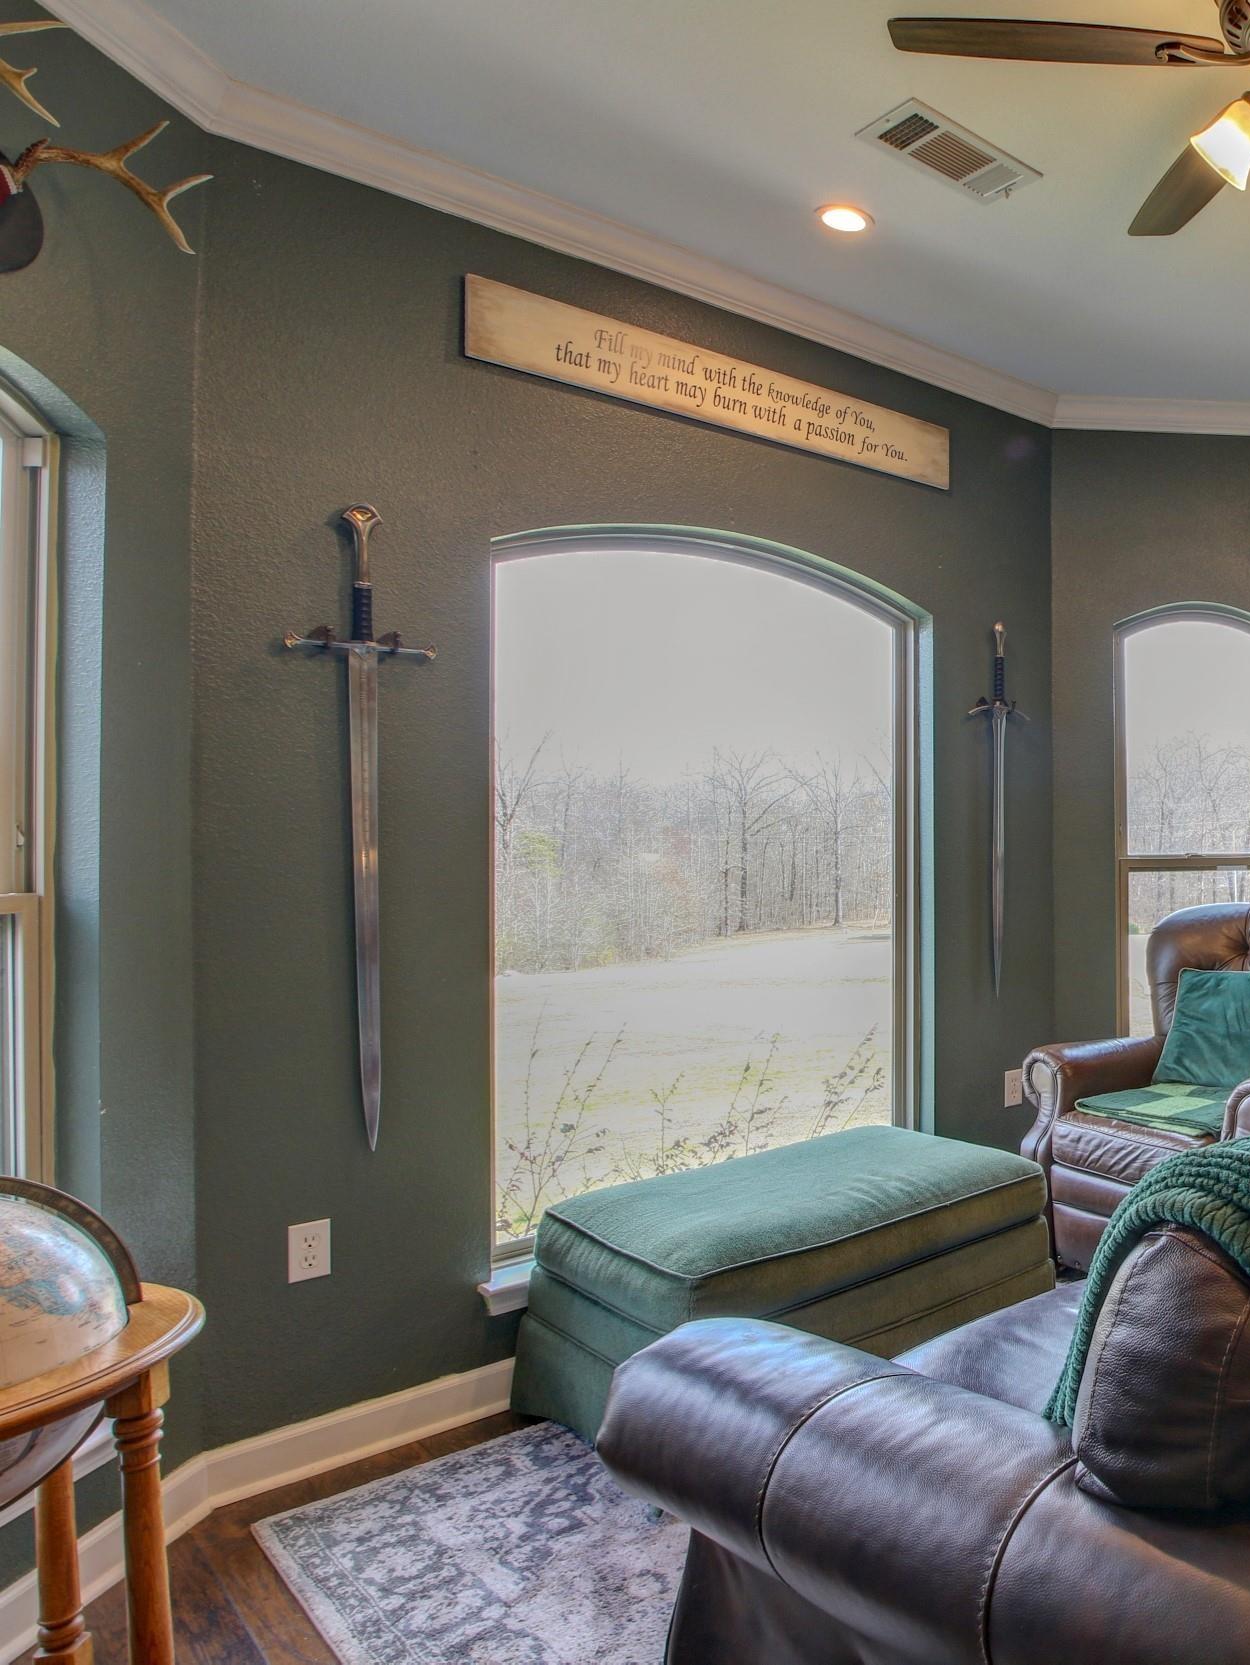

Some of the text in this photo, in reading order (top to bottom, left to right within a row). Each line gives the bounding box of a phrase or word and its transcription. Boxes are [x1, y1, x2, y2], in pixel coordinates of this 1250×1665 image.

[555, 341, 908, 462] that my heart may burn with a passion for You.
[594, 329, 876, 433] Fill my mind with the knowledge of You,
